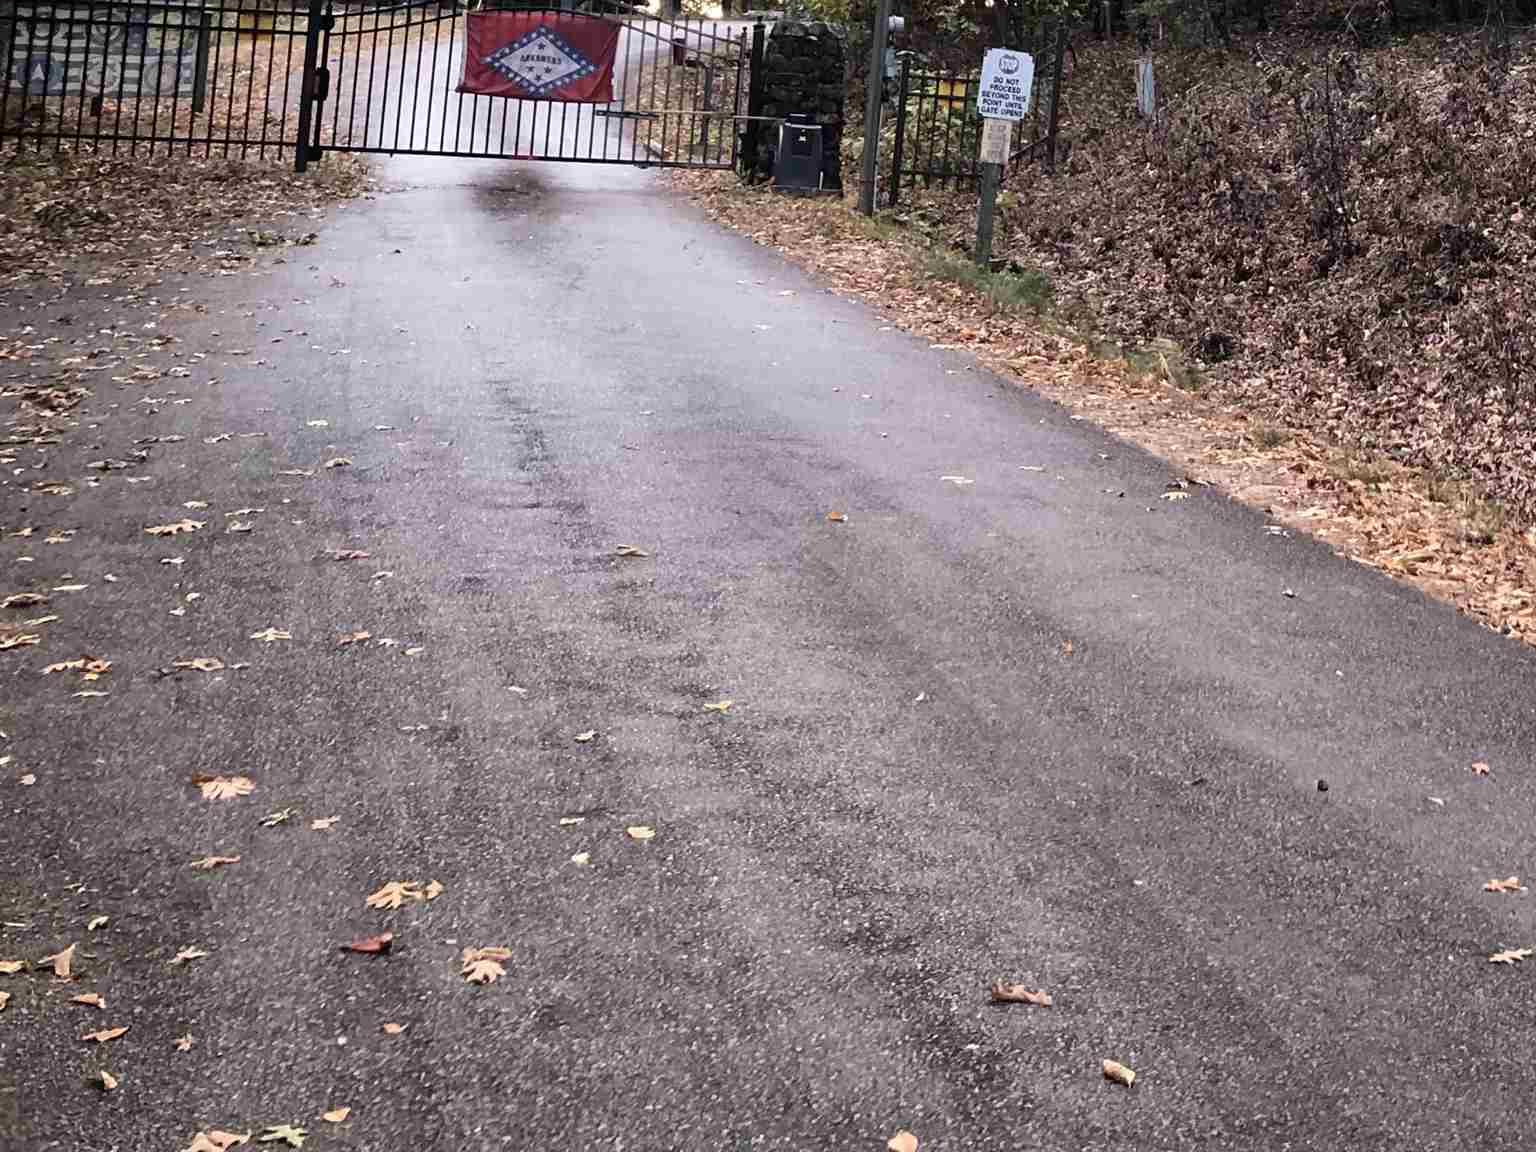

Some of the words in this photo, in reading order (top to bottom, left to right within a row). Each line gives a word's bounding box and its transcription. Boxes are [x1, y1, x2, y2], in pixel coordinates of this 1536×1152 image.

[993, 76, 1004, 84] DO
[990, 83, 1021, 94] PROCEED
[981, 90, 1010, 100] BEYOND
[982, 98, 1002, 107] POINT
[981, 105, 998, 114] GATE
[1000, 109, 1023, 117] OPENS
